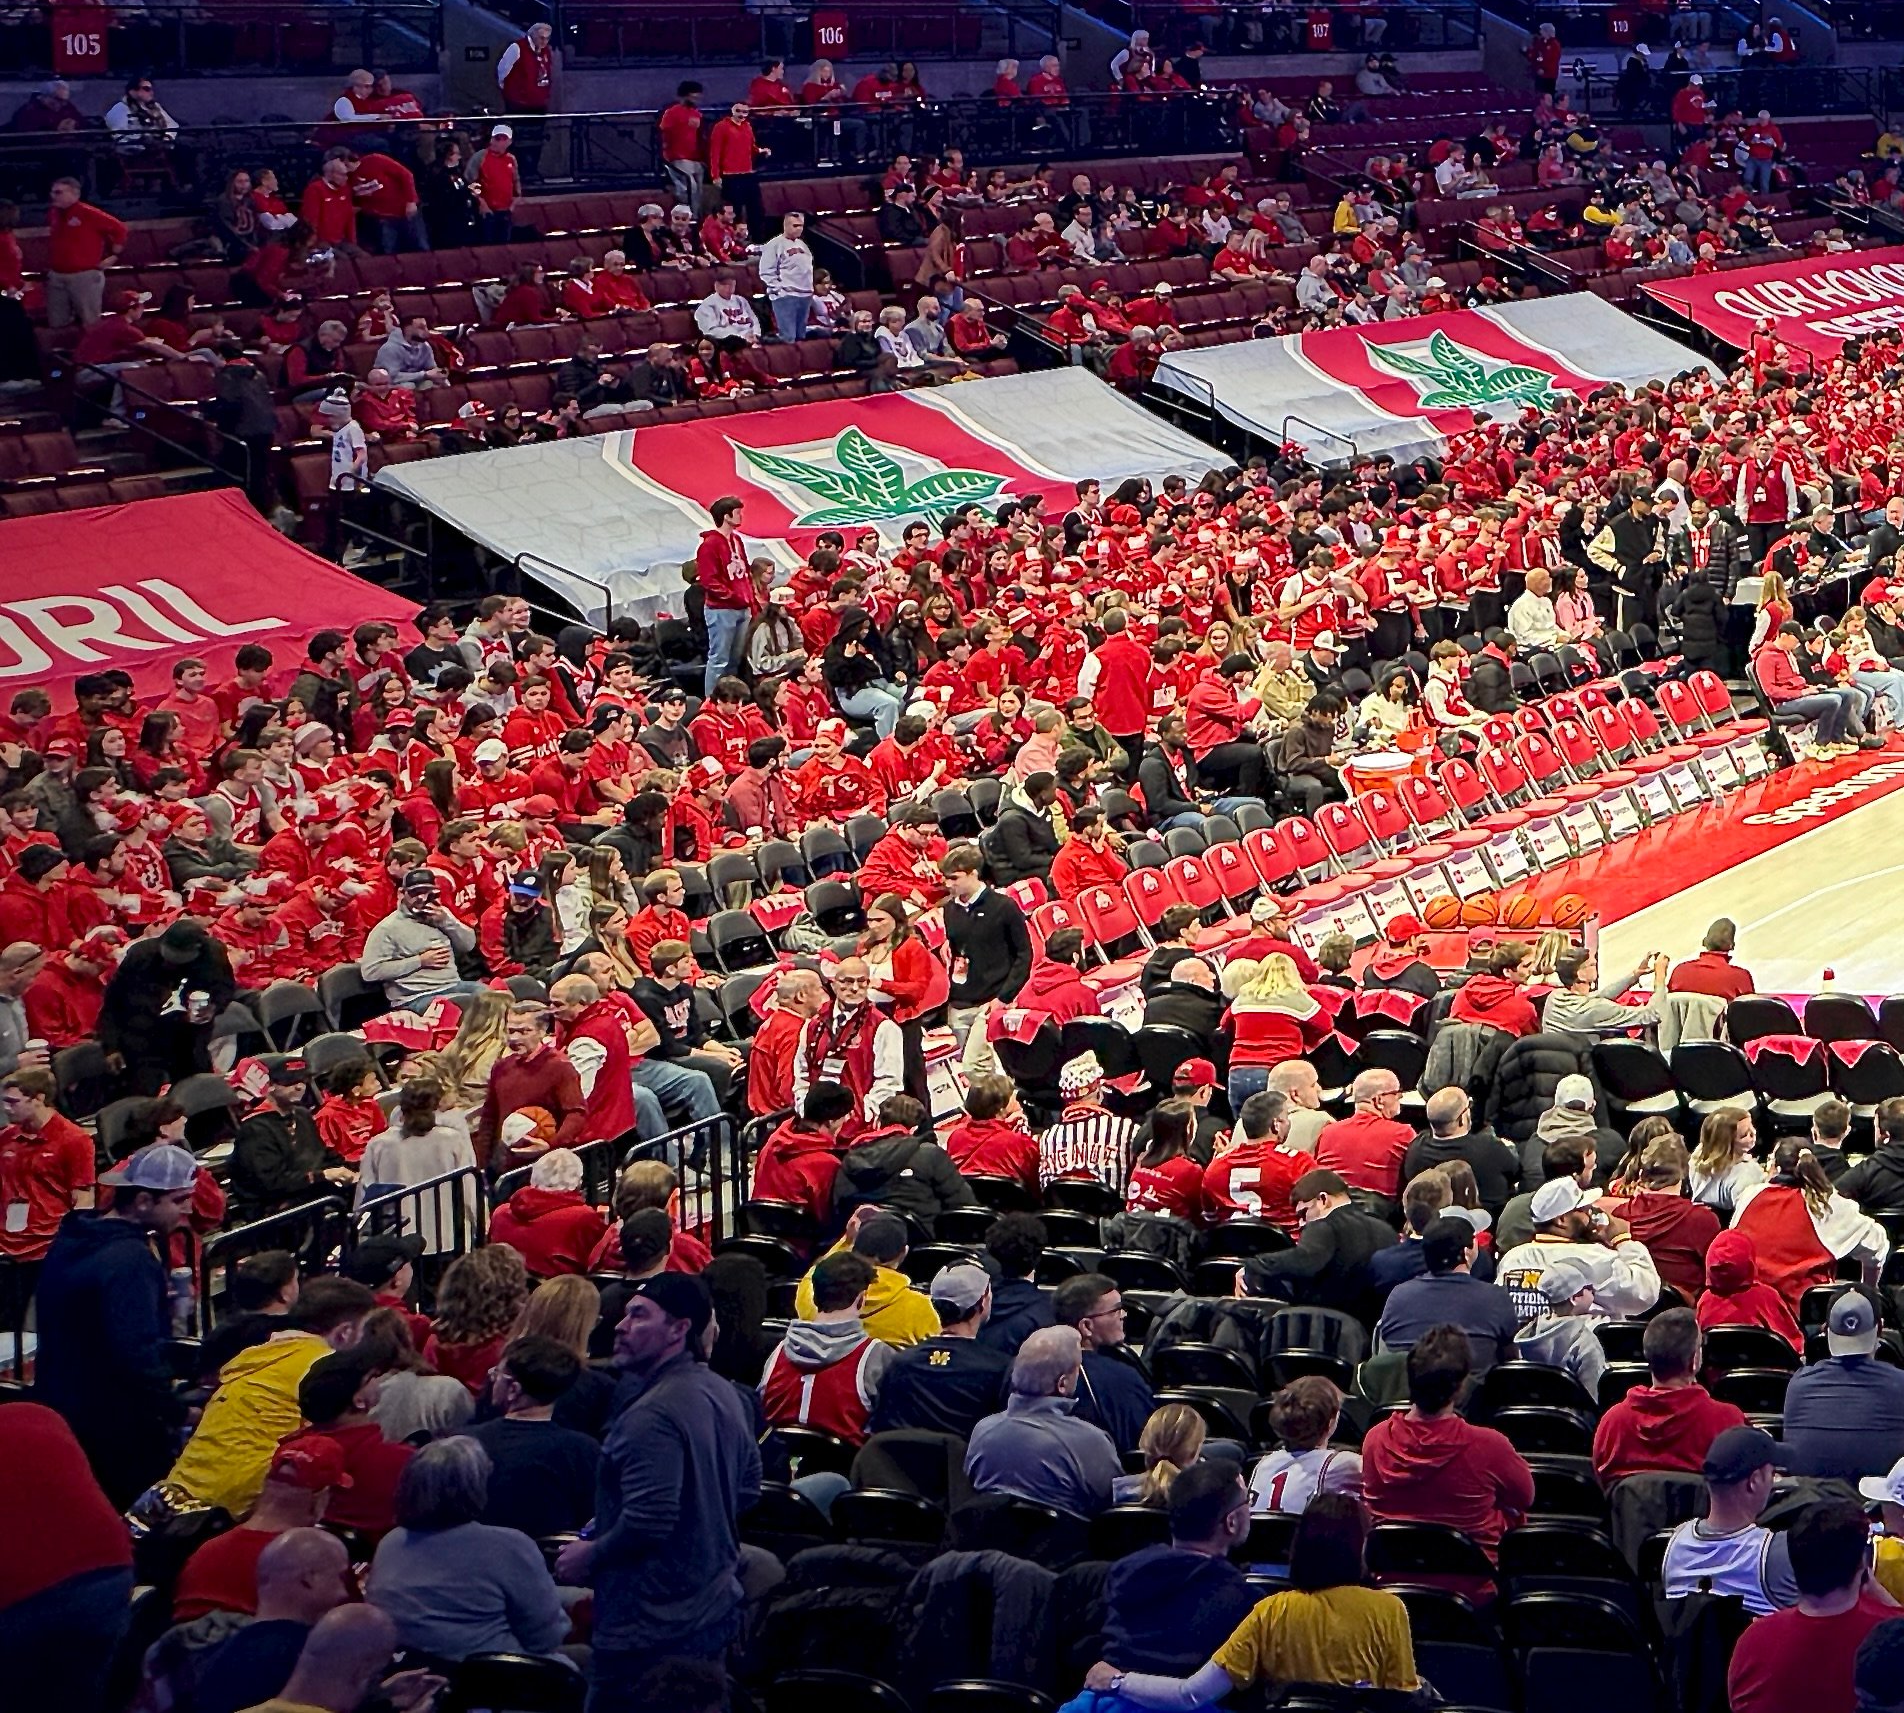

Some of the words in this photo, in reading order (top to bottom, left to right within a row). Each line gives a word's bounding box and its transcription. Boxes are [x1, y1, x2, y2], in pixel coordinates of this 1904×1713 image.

[61, 33, 101, 55] 105
[818, 26, 844, 44] 106
[1714, 279, 1816, 320] OUR
[1228, 1166, 1262, 1221] 5
[799, 1373, 817, 1424] 1
[1267, 1471, 1289, 1511] 1
